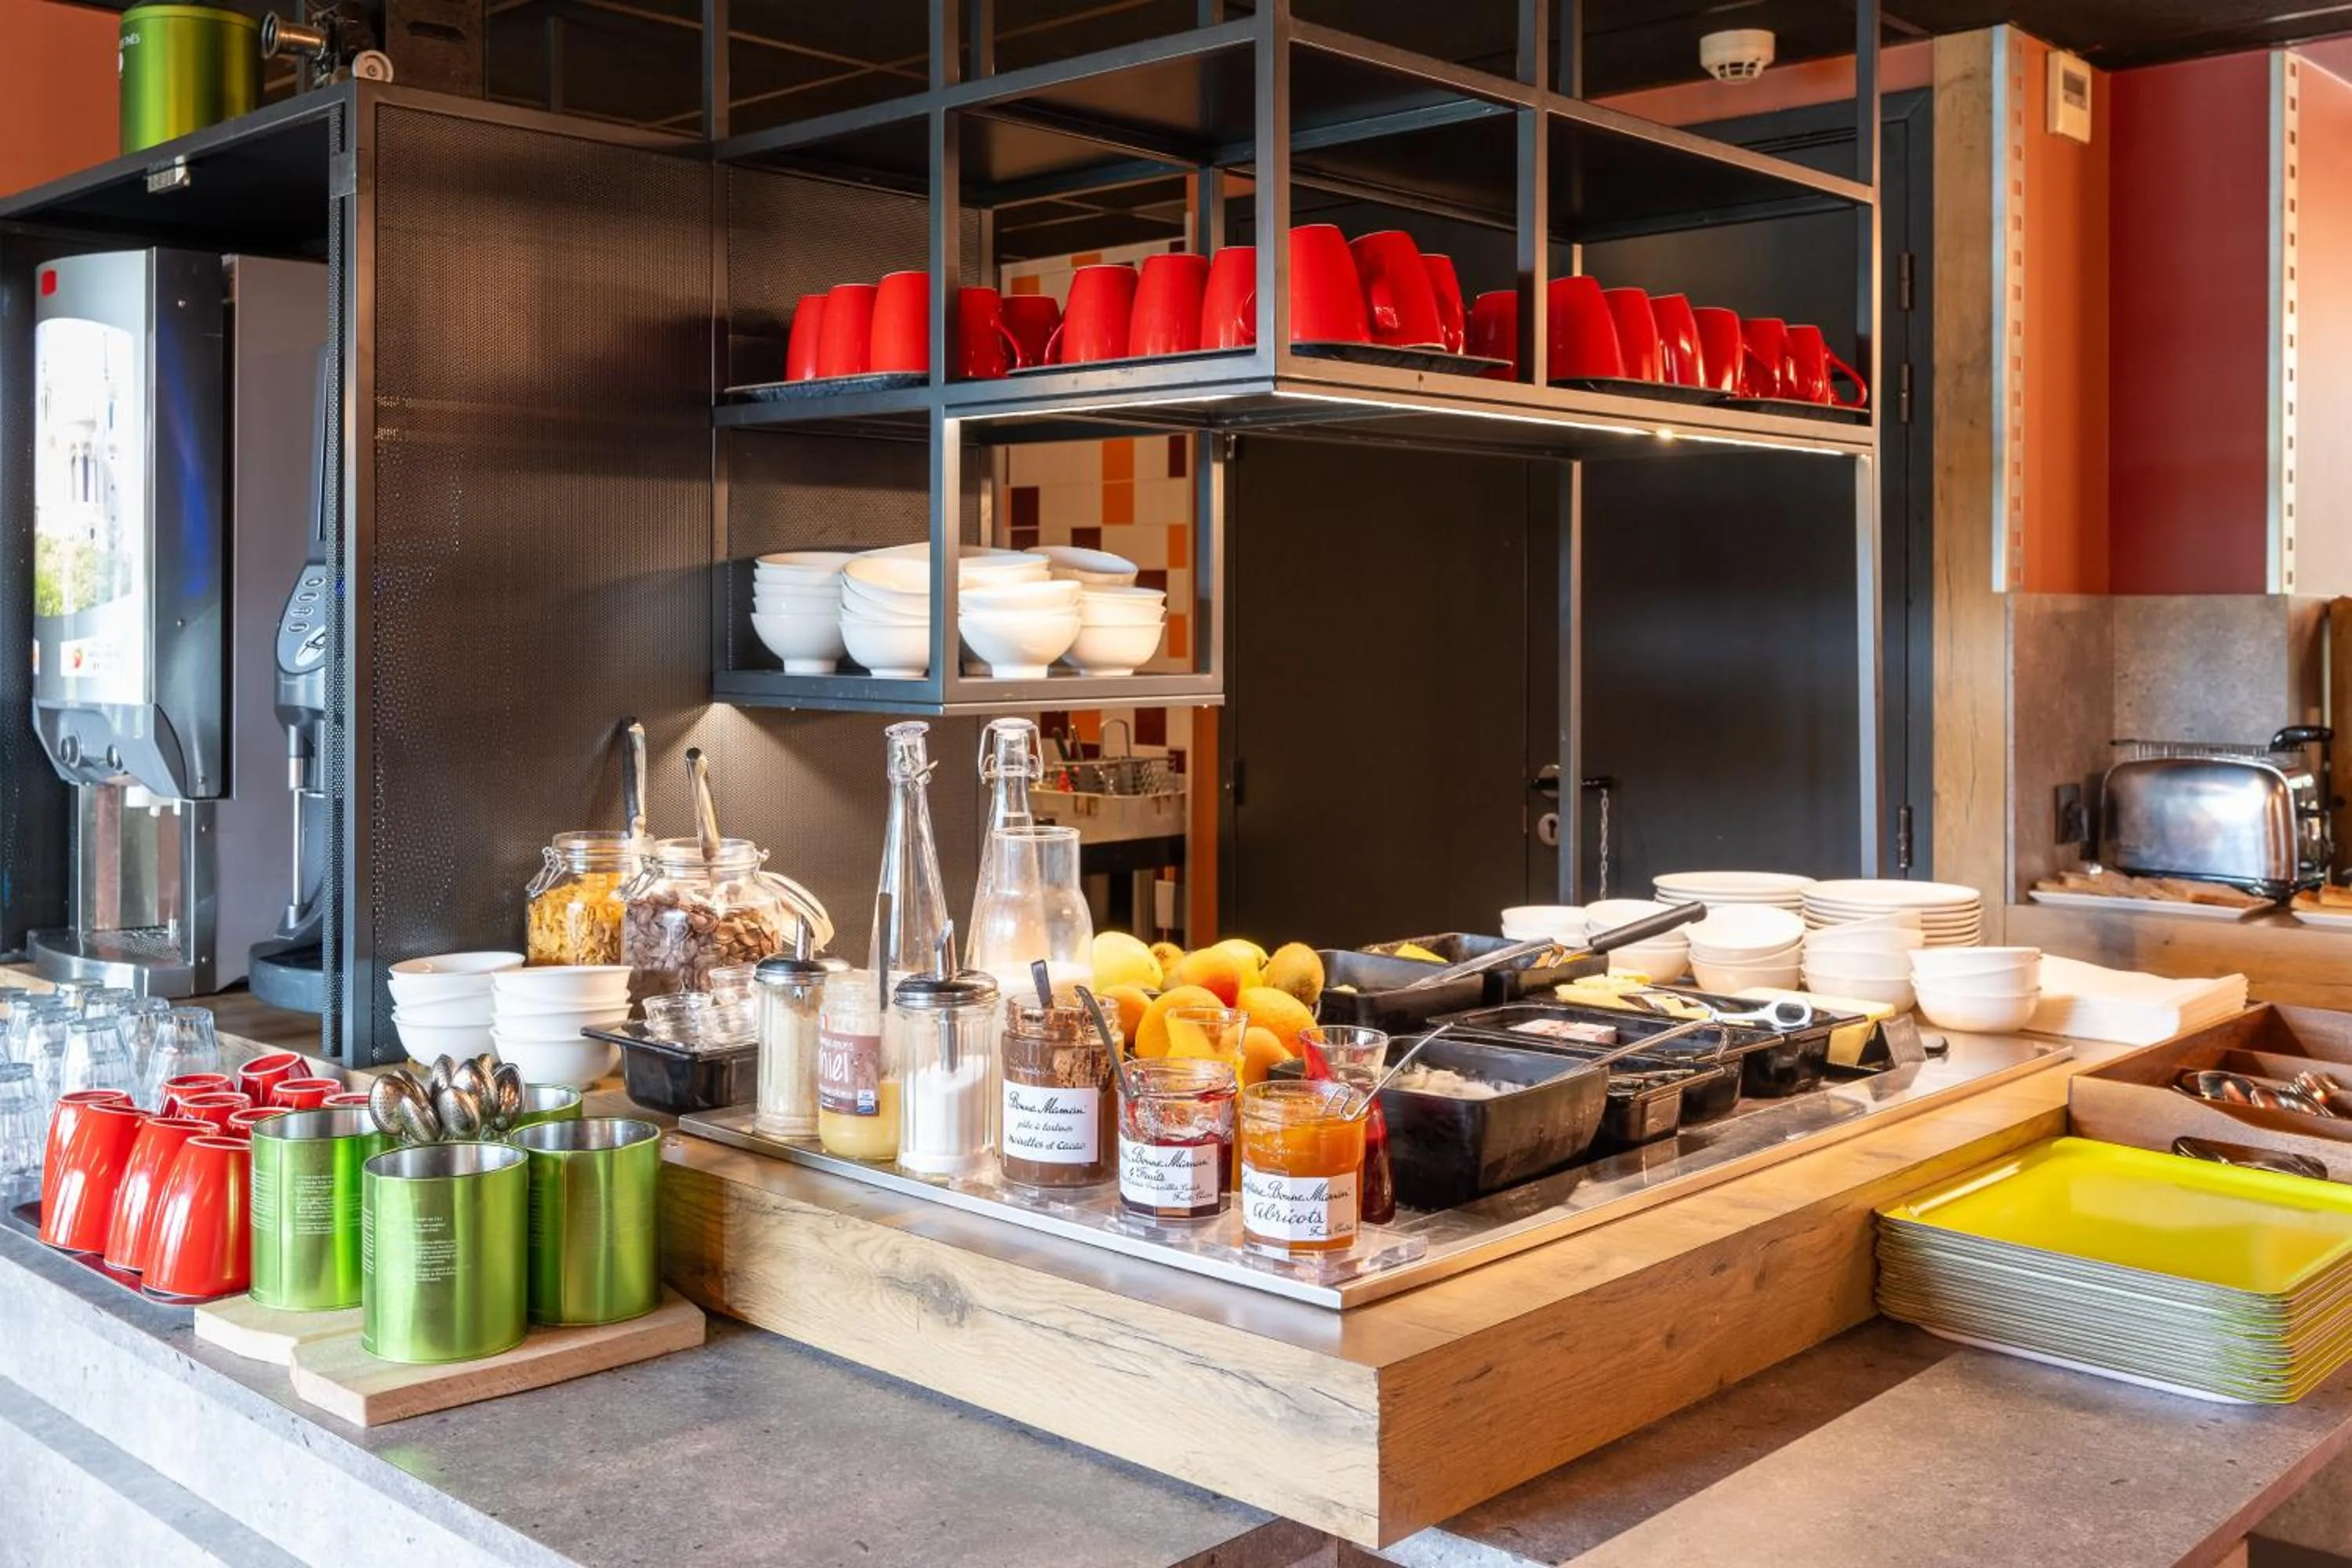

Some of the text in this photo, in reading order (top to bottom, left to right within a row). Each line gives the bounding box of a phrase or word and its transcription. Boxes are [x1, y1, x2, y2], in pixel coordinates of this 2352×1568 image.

[1008, 1091, 1086, 1114] Bonne Maman
[1130, 1146, 1163, 1167] Bonne
[1164, 1149, 1210, 1168] Maman
[1267, 1180, 1305, 1202] Bonne
[1305, 1182, 1351, 1202] Maman
[1253, 1202, 1324, 1225] Abricots
